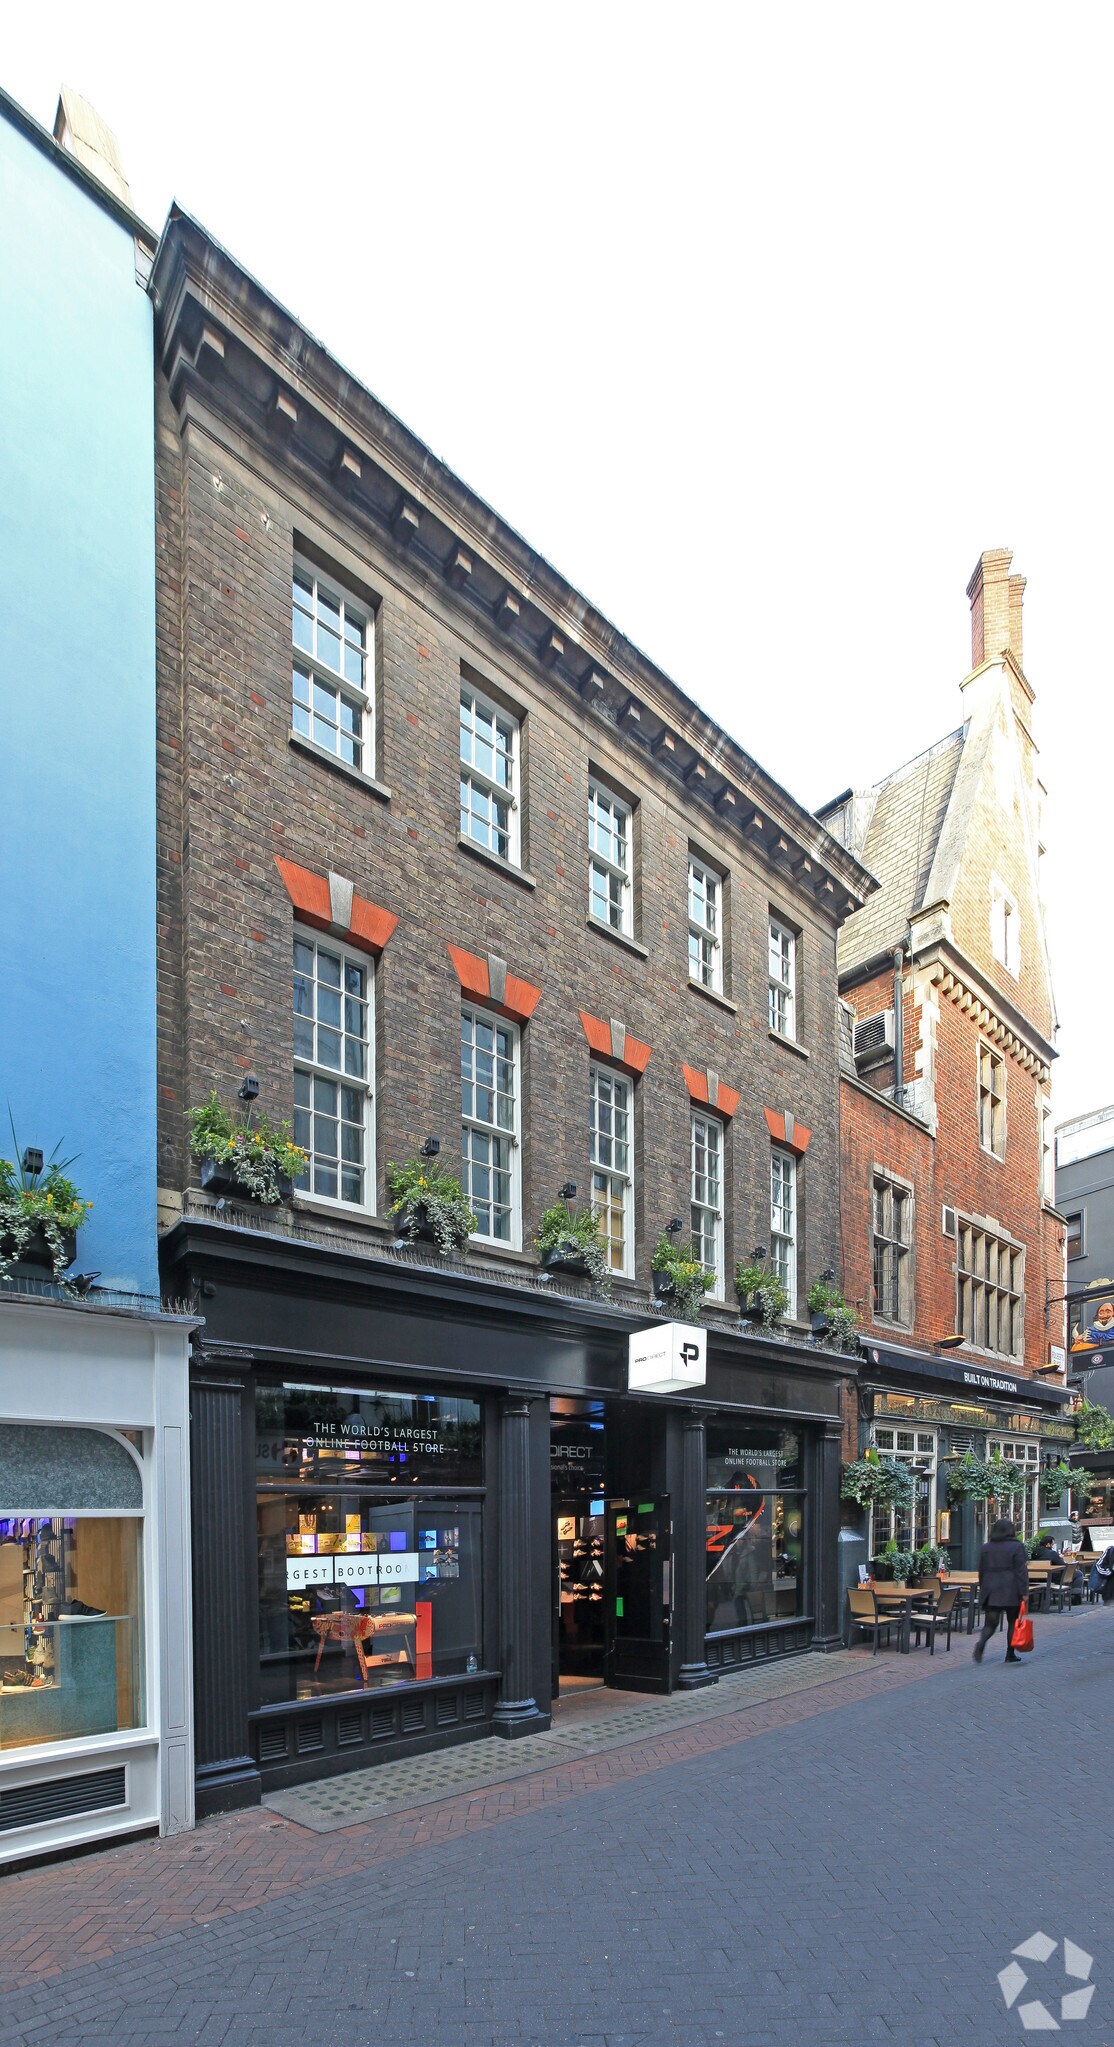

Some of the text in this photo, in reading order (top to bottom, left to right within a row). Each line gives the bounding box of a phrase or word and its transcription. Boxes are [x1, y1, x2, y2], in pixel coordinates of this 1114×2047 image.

[963, 1371, 1017, 1392] BUILT ON TRADITION
[313, 1422, 438, 1440] THE WORLD'S LARGEST
[306, 1436, 445, 1454] ONLINE FOOTBALL STORE
[550, 1445, 593, 1459] DIRECT
[728, 1447, 784, 1458] THE WORLD'S LARGEST
[724, 1457, 787, 1467] ONLINE FOOTBALL STORE
